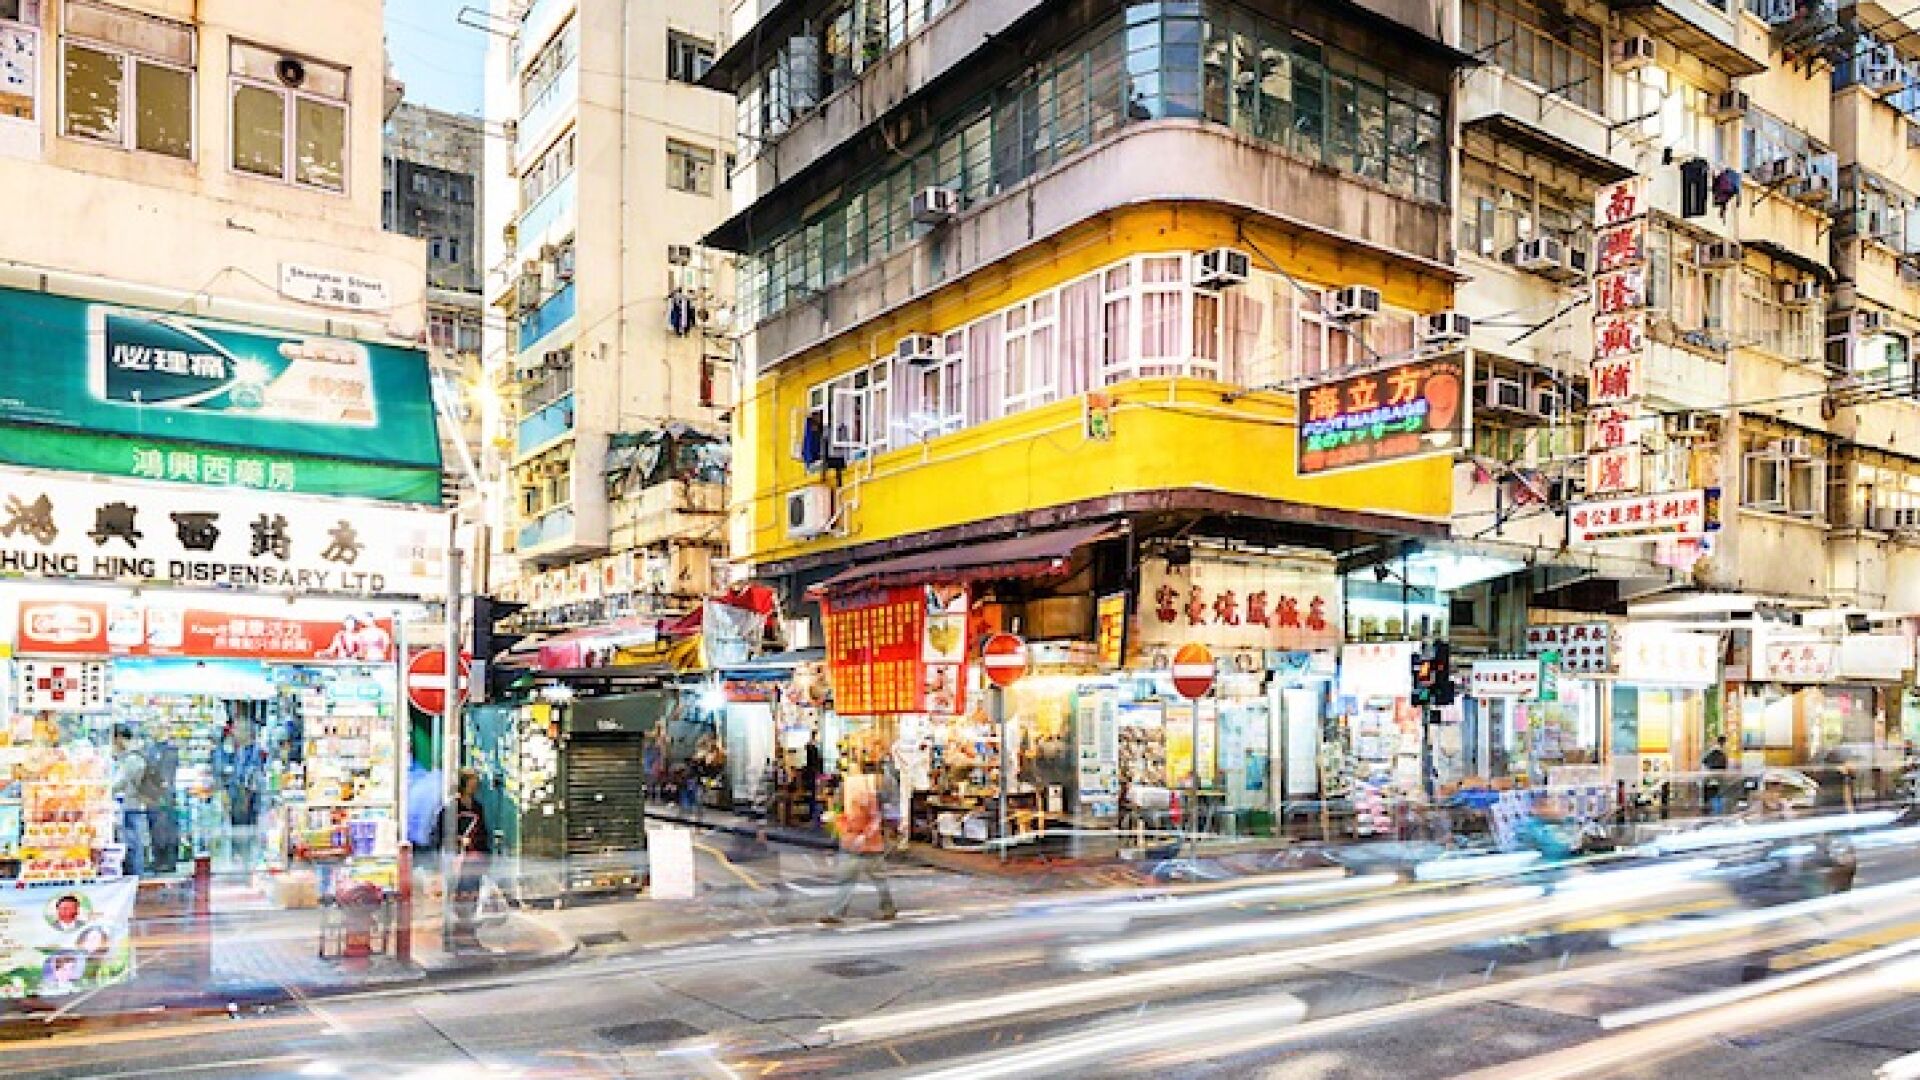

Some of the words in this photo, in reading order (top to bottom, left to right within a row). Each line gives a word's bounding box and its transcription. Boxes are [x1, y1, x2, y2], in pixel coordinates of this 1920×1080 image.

[290, 266, 341, 282] Shanghai
[348, 277, 382, 290] Street
[312, 284, 361, 303] 上海街
[112, 345, 226, 379] 必理痛
[1308, 367, 1423, 421] 海立方
[1302, 413, 1346, 437] FOOT
[1346, 398, 1428, 428] MASSAGE
[131, 446, 296, 491] 鴻興西藥房
[1, 550, 79, 574] HUNG
[93, 555, 155, 579] HING
[169, 560, 330, 588] DISPENSARY
[341, 572, 385, 592] LTD
